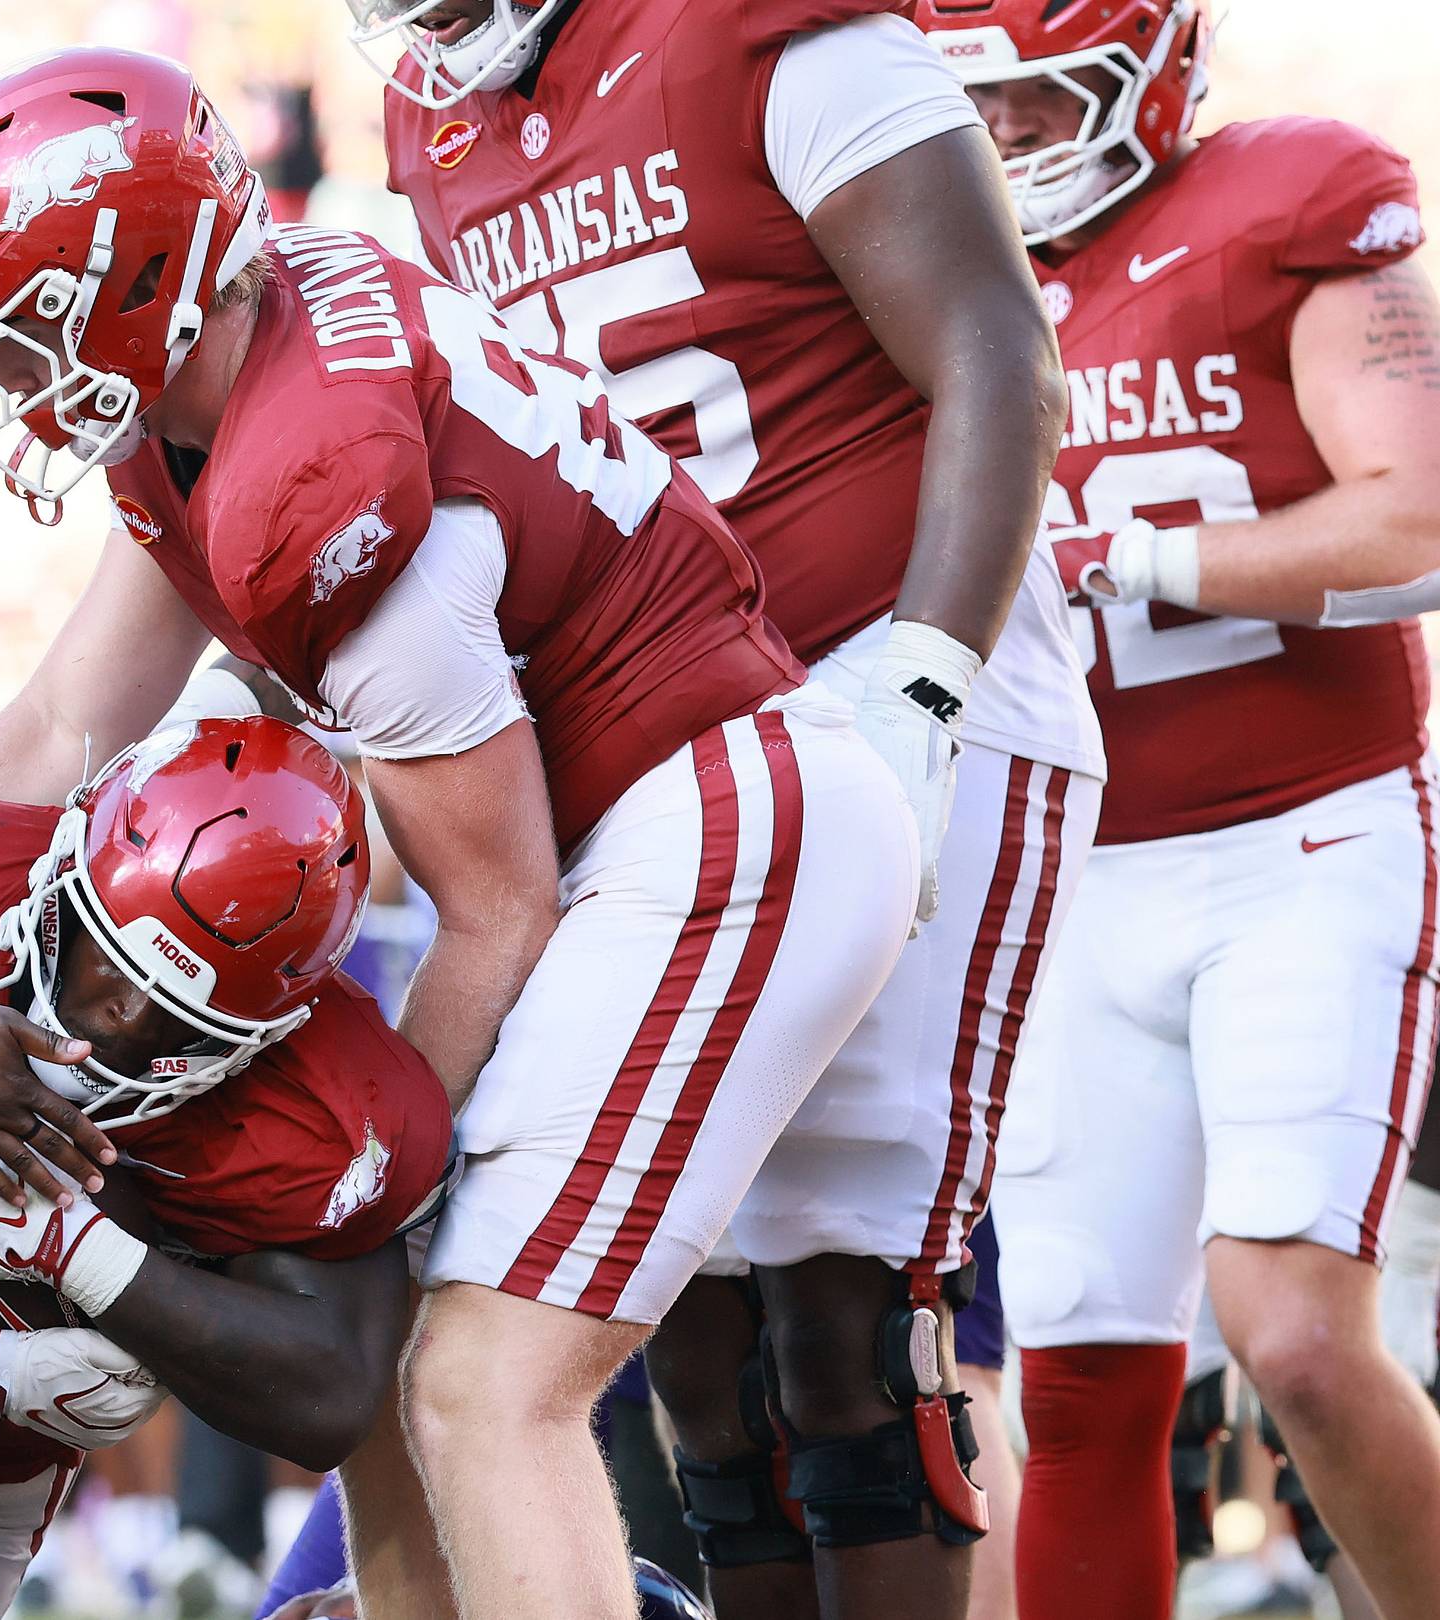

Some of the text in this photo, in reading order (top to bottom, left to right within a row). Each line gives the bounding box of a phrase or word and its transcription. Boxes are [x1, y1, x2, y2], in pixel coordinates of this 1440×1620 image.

[522, 114, 548, 157] SEC
[450, 149, 689, 301] ARKANSAS
[1059, 353, 1244, 449] NSAS
[901, 676, 963, 724] NIKE
[151, 932, 202, 980] HOGS
